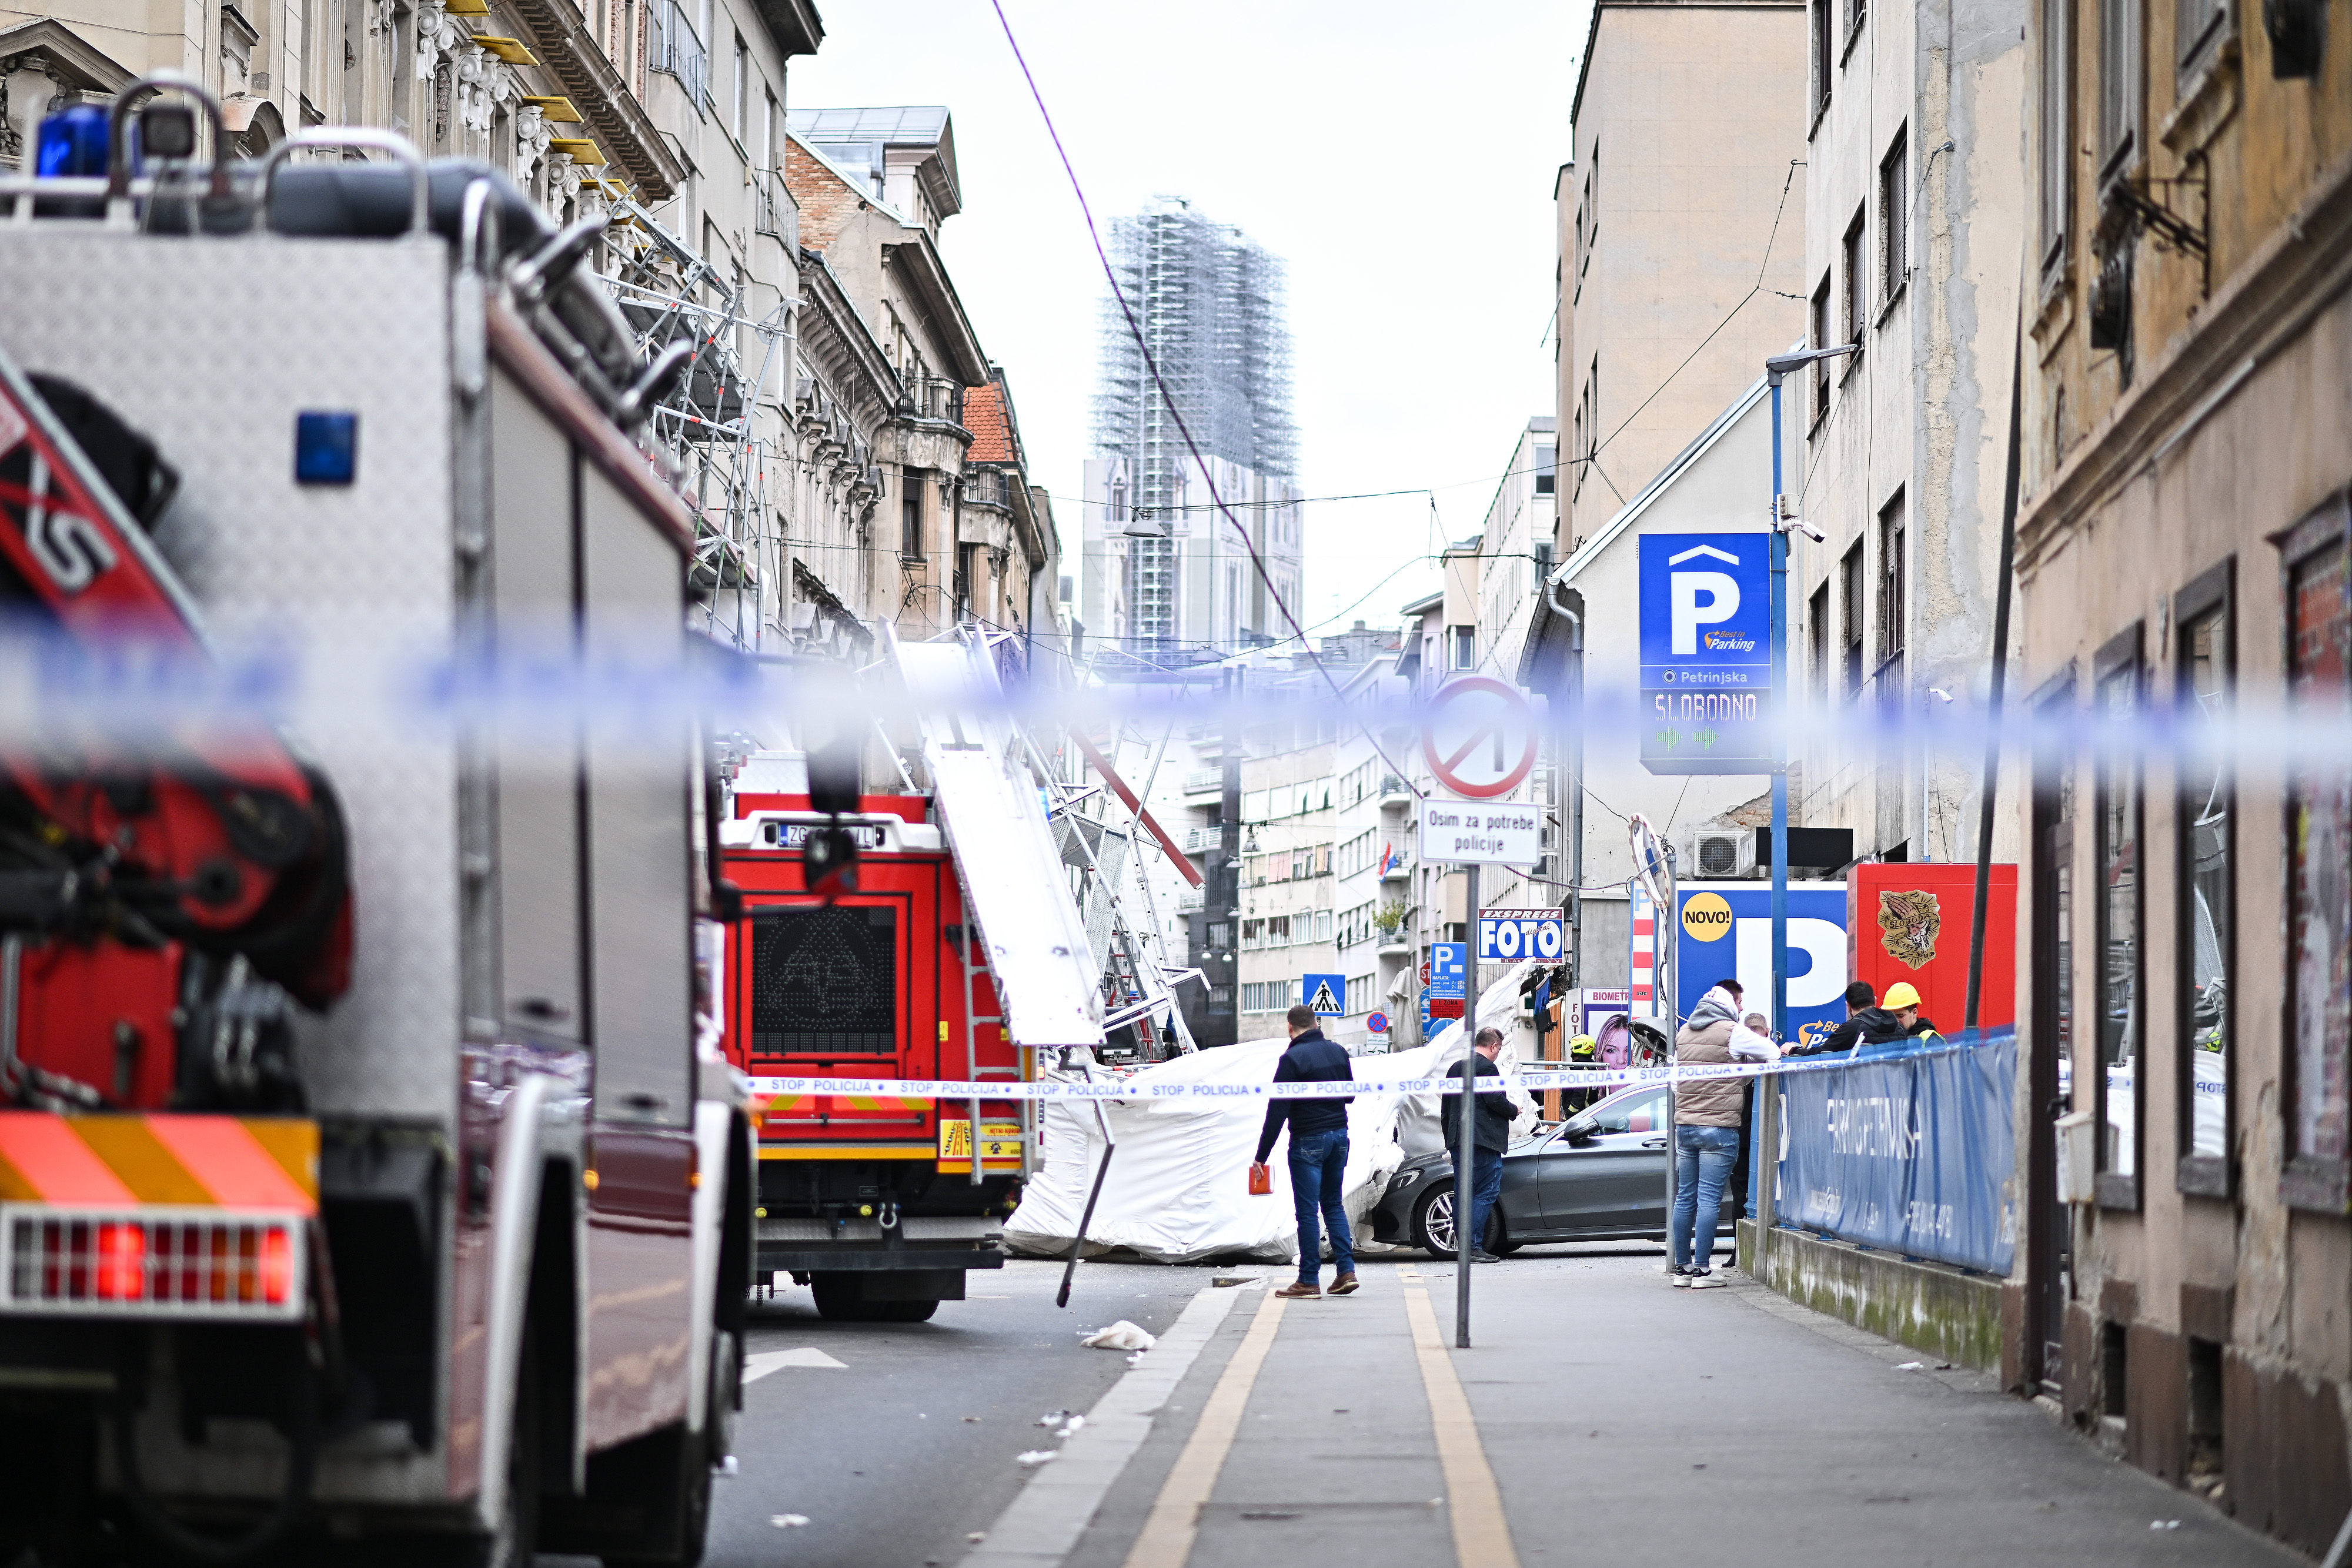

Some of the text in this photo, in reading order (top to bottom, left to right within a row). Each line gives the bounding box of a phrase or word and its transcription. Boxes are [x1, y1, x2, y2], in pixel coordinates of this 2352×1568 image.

[1671, 572, 1740, 654] P
[1719, 630, 1738, 638] Best
[1709, 638, 1755, 652] Parking
[1681, 671, 1748, 684] Petrinjska
[1655, 693, 1757, 721] SLOBODNO
[1429, 810, 1534, 831] Osim za potrebe
[790, 827, 807, 842] ZG
[1455, 835, 1504, 854] policije
[1482, 910, 1559, 918] EXSPRESS
[1685, 911, 1730, 924] NOVO!
[1889, 914, 1932, 928] SLOBODA
[1526, 922, 1551, 937] digital
[1481, 921, 1561, 957] FOTO
[1435, 947, 1453, 972] P
[772, 1079, 805, 1089] STOP
[814, 1081, 871, 1092] POLICIJA
[901, 1082, 934, 1092] STOP
[942, 1083, 998, 1094] POLICIJA
[1027, 1085, 1059, 1094] STOP
[1068, 1085, 1124, 1095] POLICIJA
[1153, 1085, 1184, 1095] STOP
[1193, 1085, 1249, 1095] POLICIJA
[1277, 1084, 1308, 1094] STOP
[1317, 1083, 1372, 1093] POLICIJA
[1399, 1081, 1430, 1091] STOP
[1439, 1078, 1493, 1089] POLIJA
[1521, 1075, 1551, 1086] STOP
[1559, 1072, 1613, 1083] POLICIJA
[1640, 1069, 1670, 1079] STOP
[1678, 1066, 1731, 1076] POLICIJA
